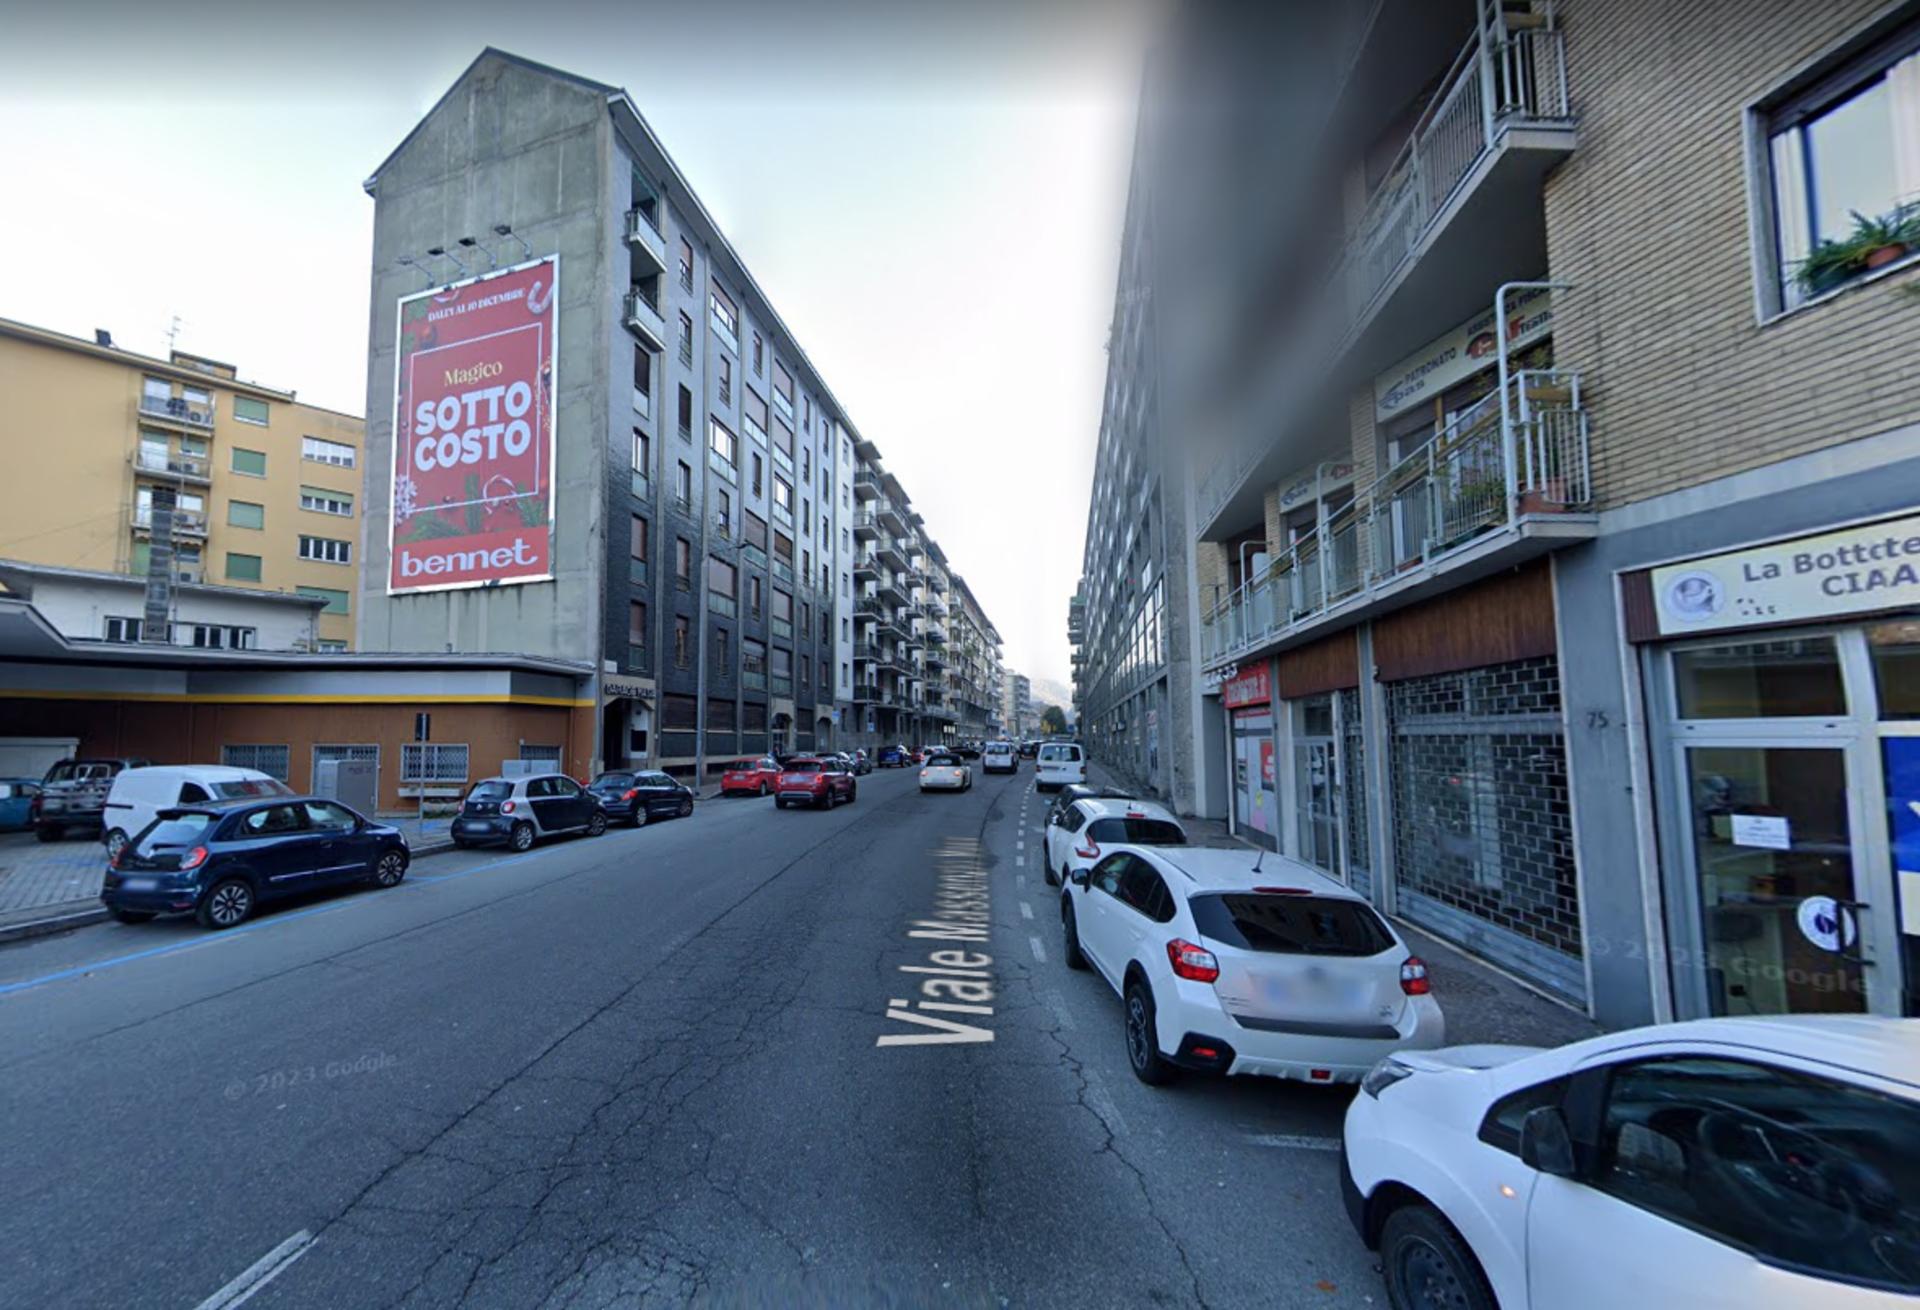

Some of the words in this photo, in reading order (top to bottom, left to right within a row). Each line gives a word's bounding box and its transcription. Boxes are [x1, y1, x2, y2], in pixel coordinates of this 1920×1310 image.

[444, 361, 503, 387] Magico
[415, 380, 532, 435] SOTTO
[414, 419, 532, 472] COSTO
[401, 538, 539, 577] bennet
[1743, 562, 1781, 583] La
[1821, 563, 1918, 597] CIAA
[1587, 711, 1609, 729] 75
